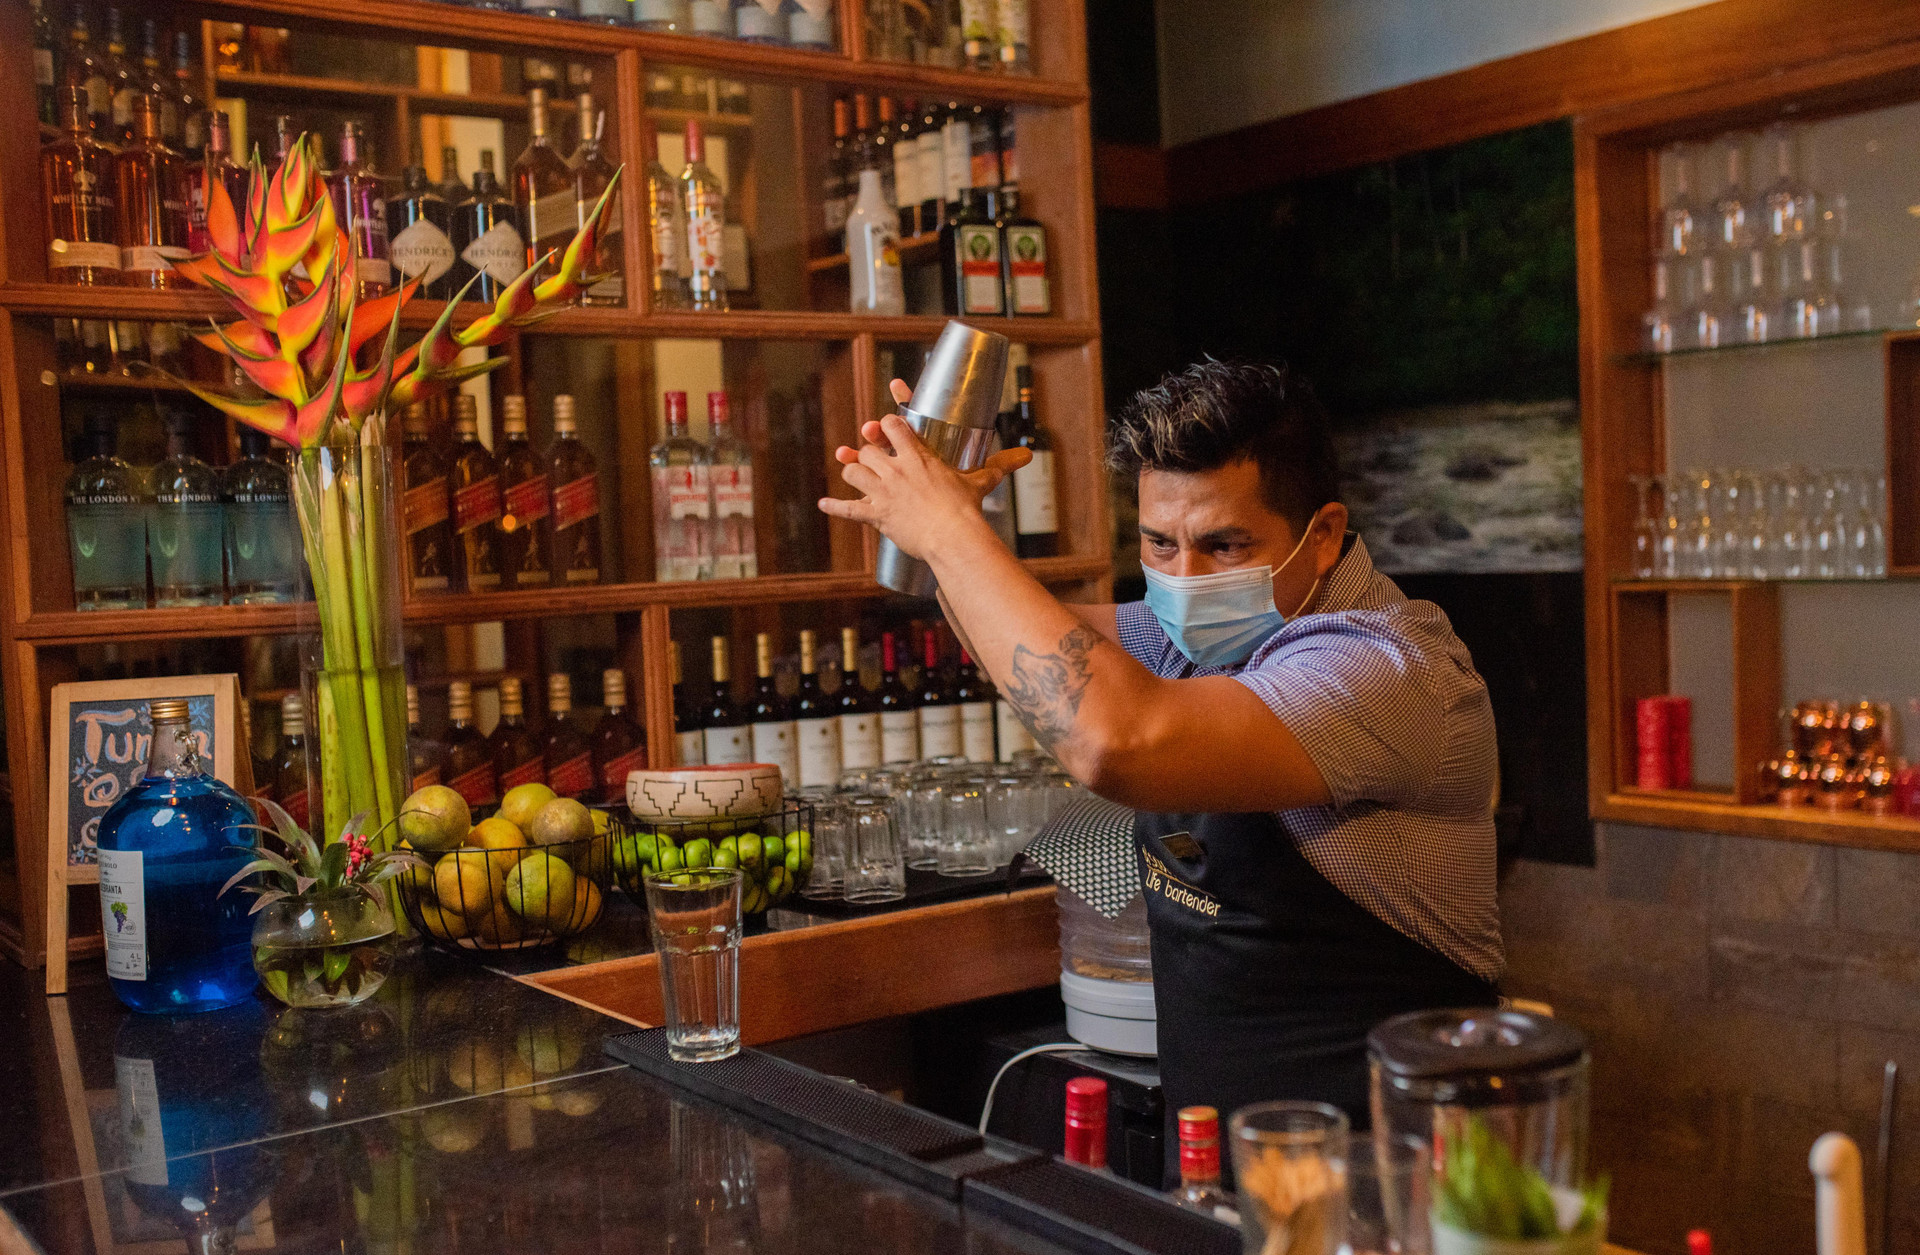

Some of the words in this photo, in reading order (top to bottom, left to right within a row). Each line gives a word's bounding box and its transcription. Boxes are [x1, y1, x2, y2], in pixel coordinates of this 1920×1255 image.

[89, 494, 128, 504] LONDON
[235, 493, 251, 503] THE
[1164, 879, 1221, 917] bartender
